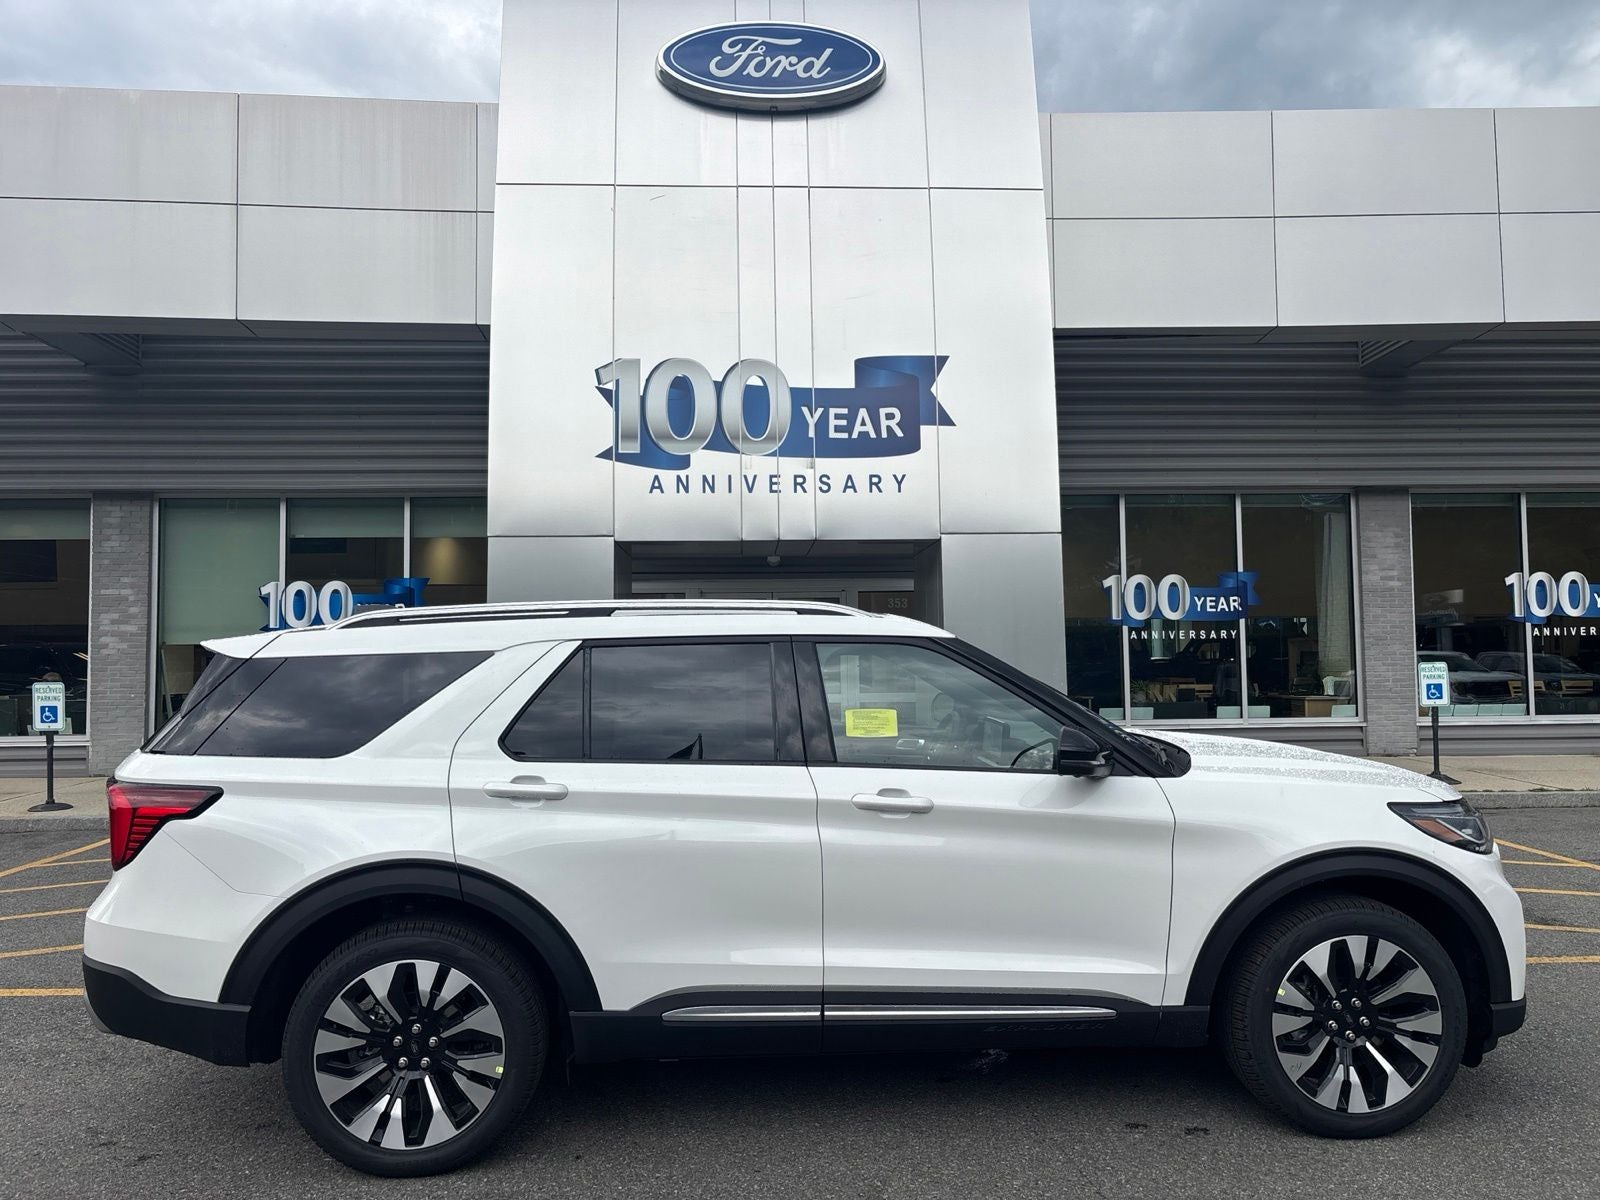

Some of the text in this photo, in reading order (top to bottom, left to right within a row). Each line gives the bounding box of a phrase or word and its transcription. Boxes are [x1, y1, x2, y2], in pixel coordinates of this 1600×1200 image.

[709, 35, 833, 79] Ford
[596, 357, 904, 456] 100 YEAR
[649, 474, 907, 494] ANNIVERSARY
[260, 580, 353, 629] 100
[888, 598, 908, 608] 353
[1102, 574, 1242, 620] 100 YEAR
[1504, 571, 1590, 617] 100
[1130, 630, 1238, 640] ANNIVERSARY
